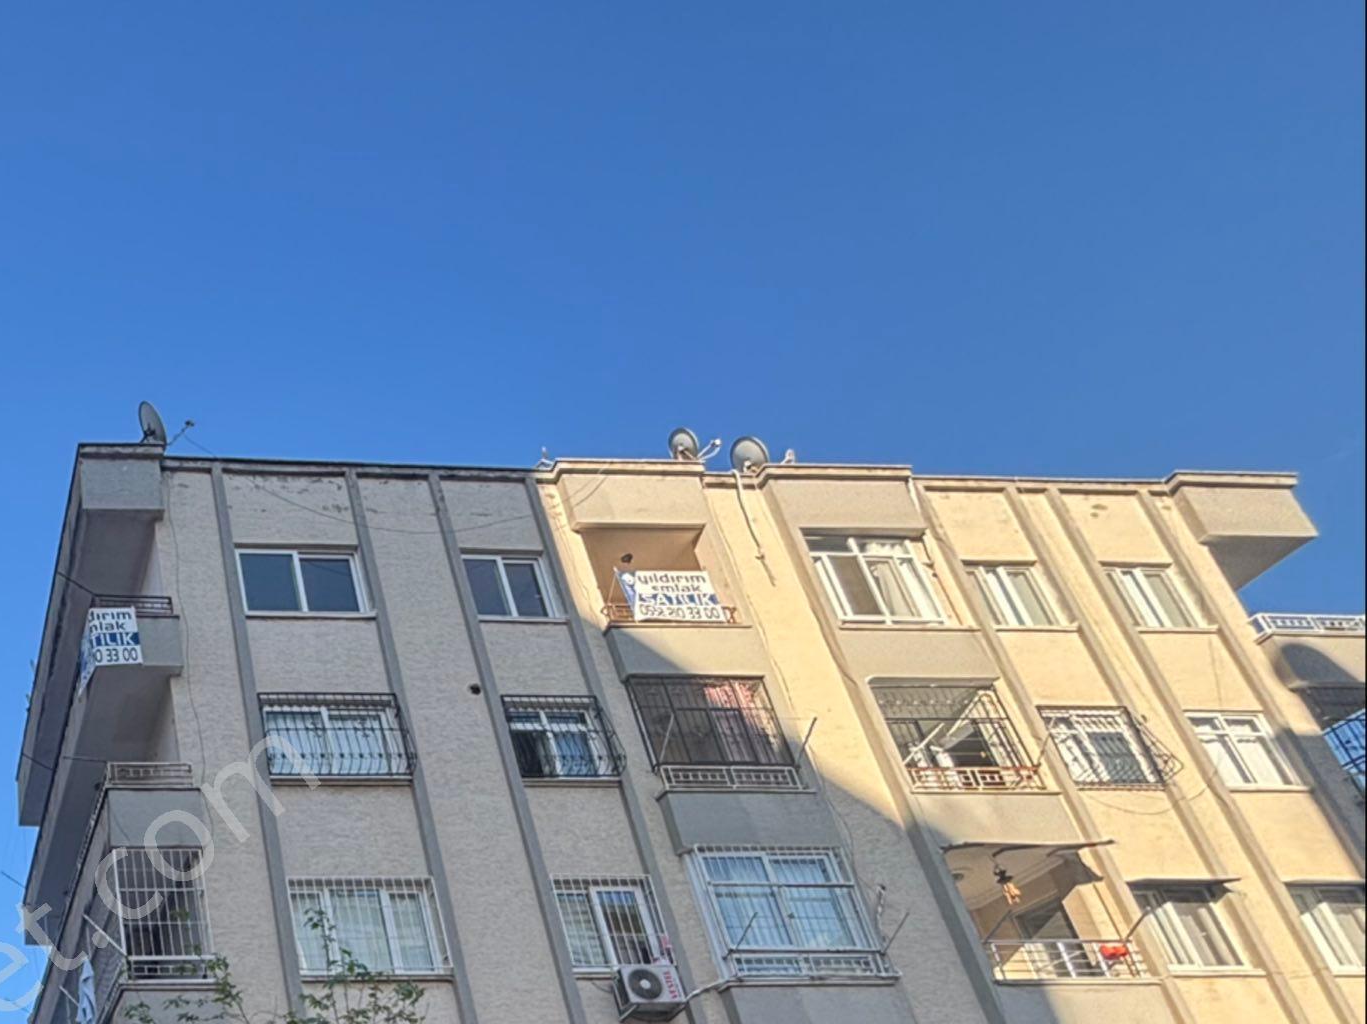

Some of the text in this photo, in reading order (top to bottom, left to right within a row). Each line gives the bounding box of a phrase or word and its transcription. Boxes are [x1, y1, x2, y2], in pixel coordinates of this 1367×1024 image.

[639, 593, 712, 605] SATILIK
[106, 648, 119, 662] 33
[122, 647, 139, 662] 00
